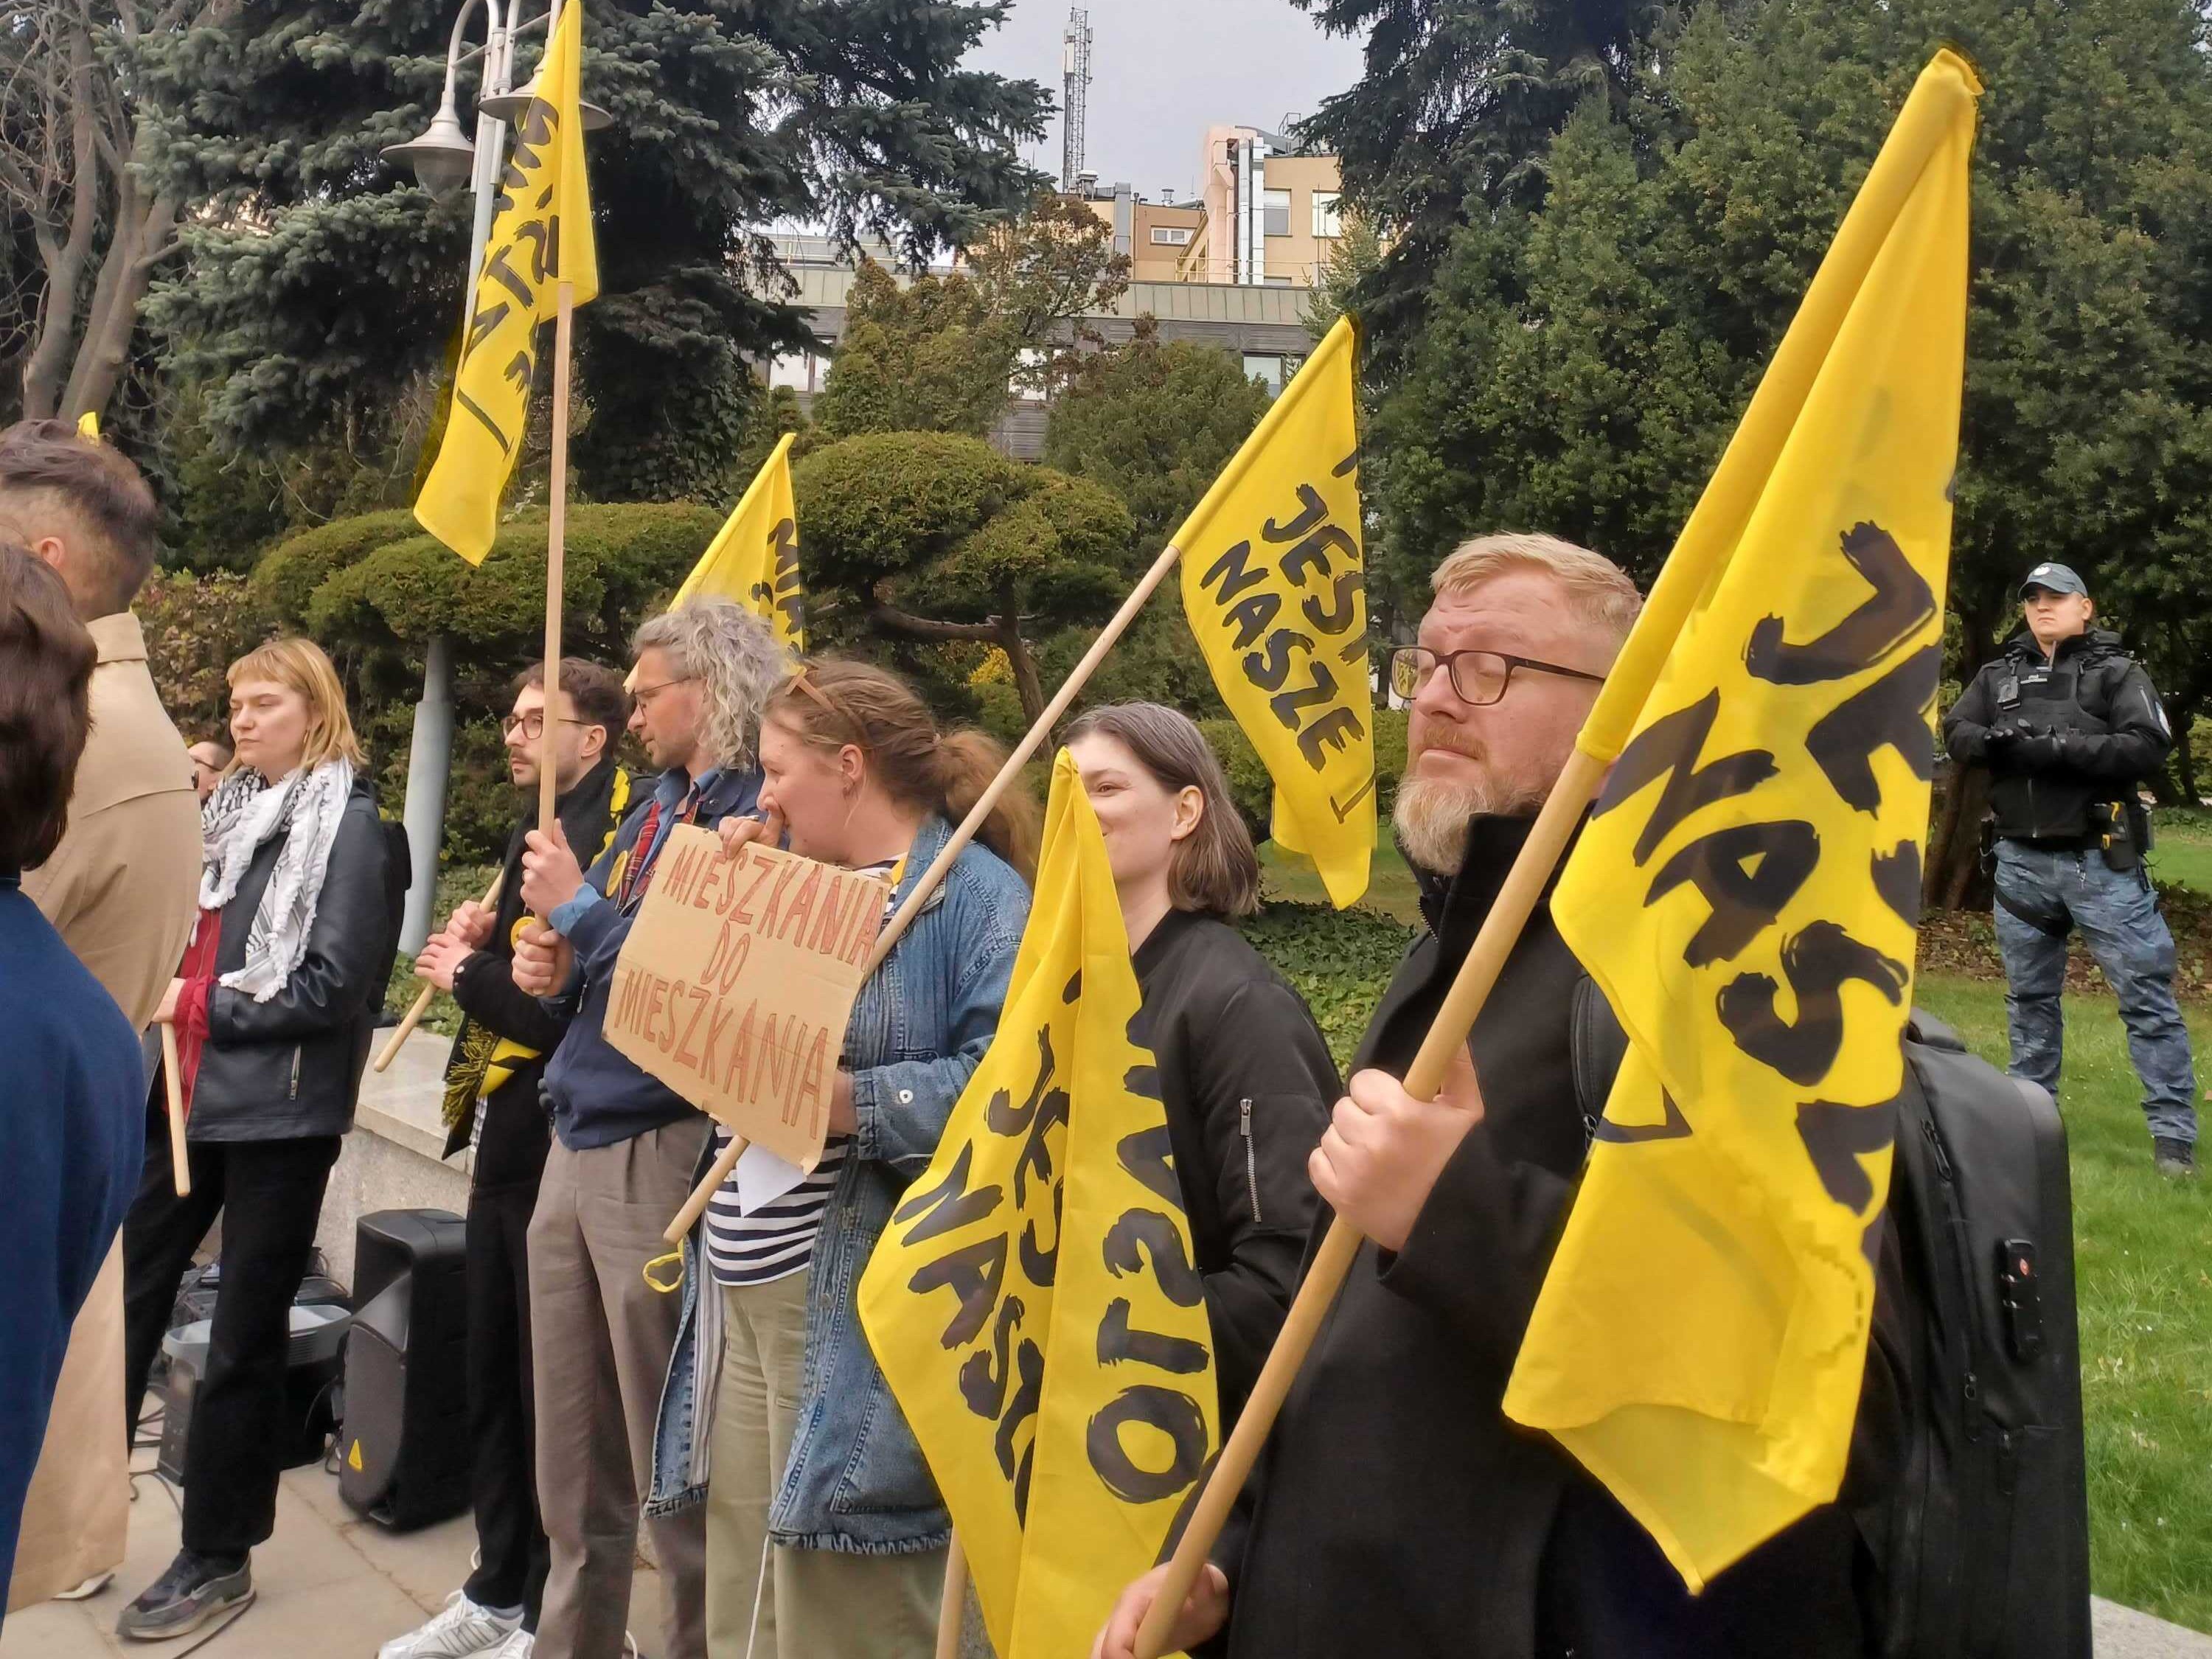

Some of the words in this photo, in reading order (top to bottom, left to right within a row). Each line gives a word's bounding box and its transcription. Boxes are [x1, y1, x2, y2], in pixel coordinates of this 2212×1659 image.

[1200, 539, 1366, 774] NASZE
[661, 844, 885, 972] MIESZKANIA
[700, 919, 751, 995] DO
[613, 968, 828, 1140] MIESZKANIA
